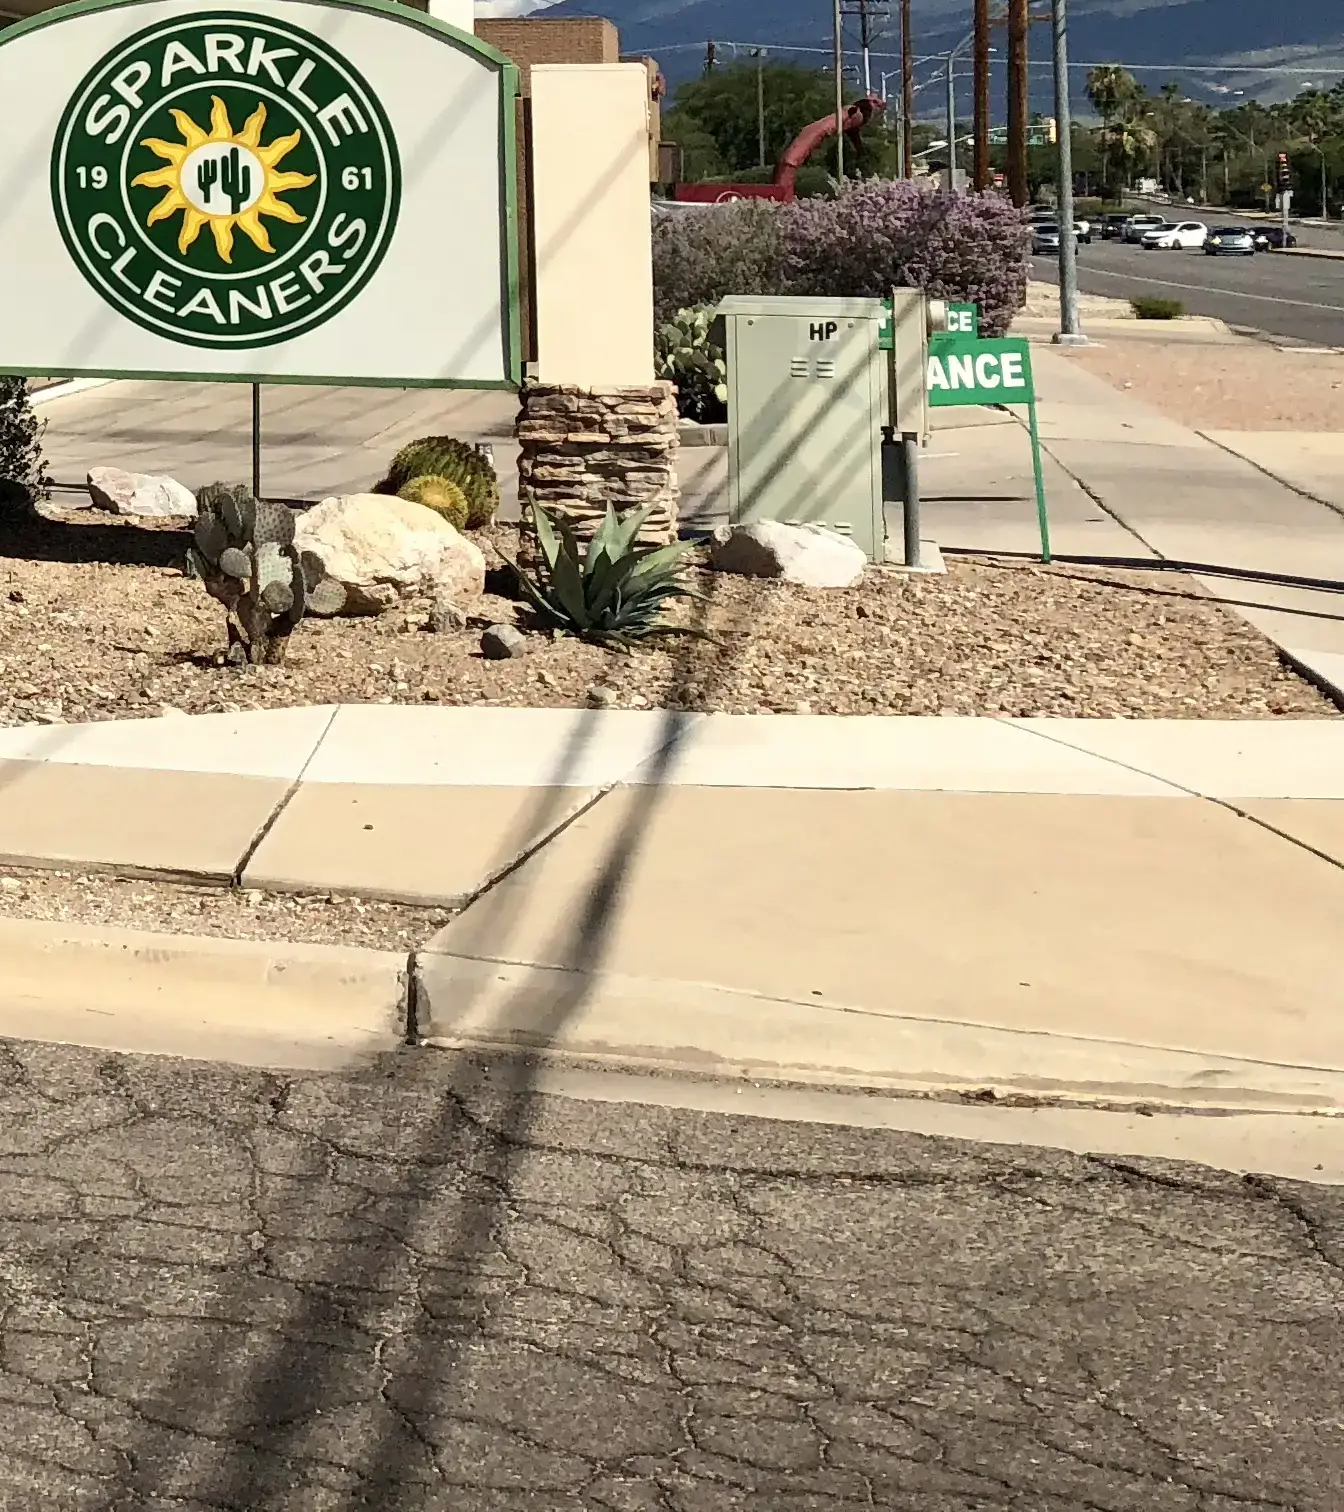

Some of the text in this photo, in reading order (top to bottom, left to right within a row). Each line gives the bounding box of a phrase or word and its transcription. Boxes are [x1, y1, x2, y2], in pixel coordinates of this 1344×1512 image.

[84, 33, 369, 147] SPARKLE
[76, 166, 372, 190] 19 61
[87, 212, 367, 324] CLEANERS
[809, 321, 838, 341] HP
